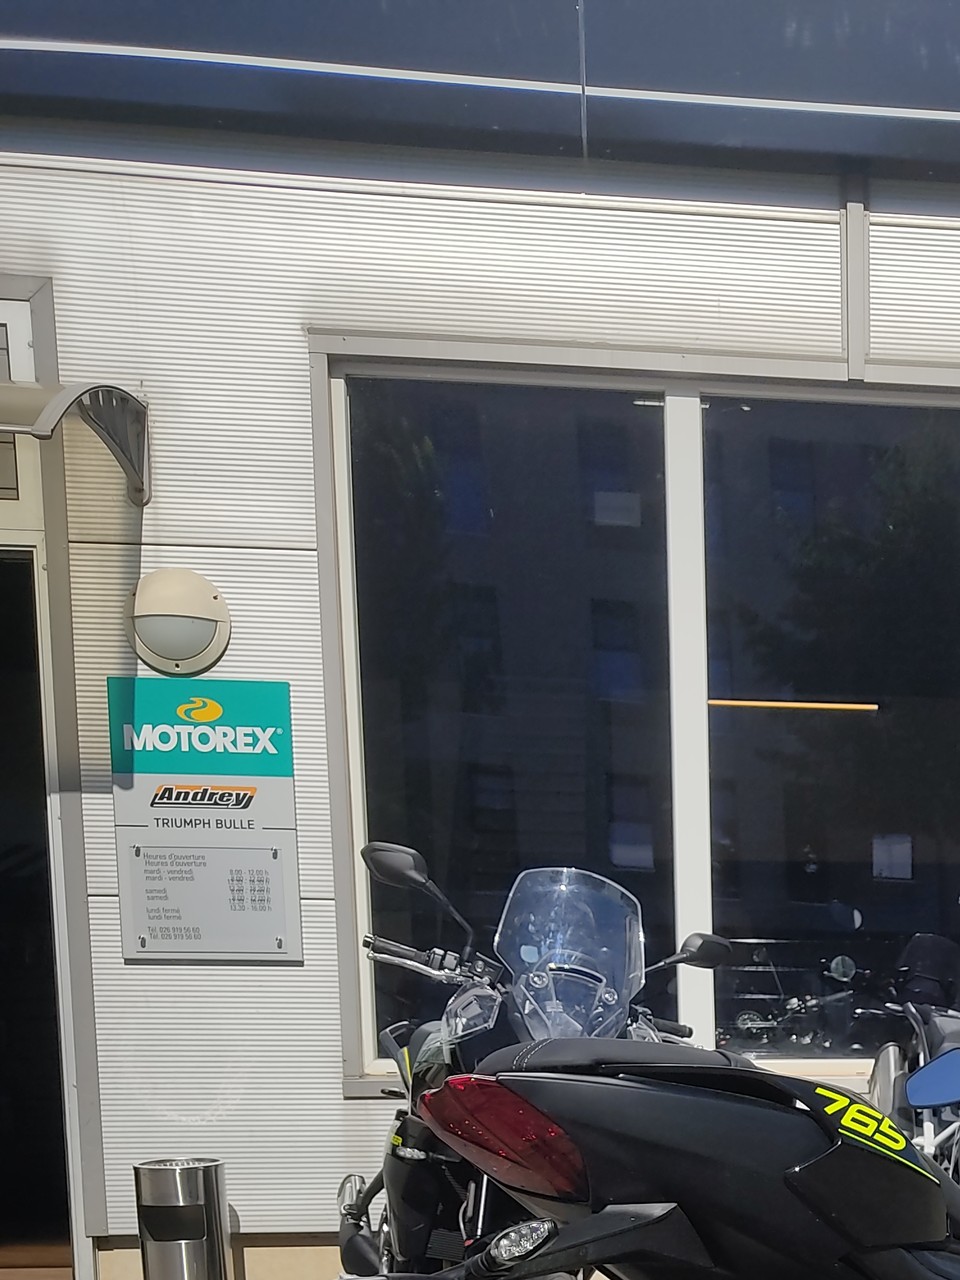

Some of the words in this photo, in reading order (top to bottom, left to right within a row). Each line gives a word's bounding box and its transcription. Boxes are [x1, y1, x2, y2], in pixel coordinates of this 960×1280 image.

[123, 723, 279, 755] MOTOREX
[157, 786, 249, 807] Andrey
[153, 817, 211, 829] TRIUMPH
[215, 818, 256, 830] BULLE
[143, 852, 167, 861] Heures
[168, 853, 206, 861] d'ouverture
[814, 1087, 907, 1152] 765
